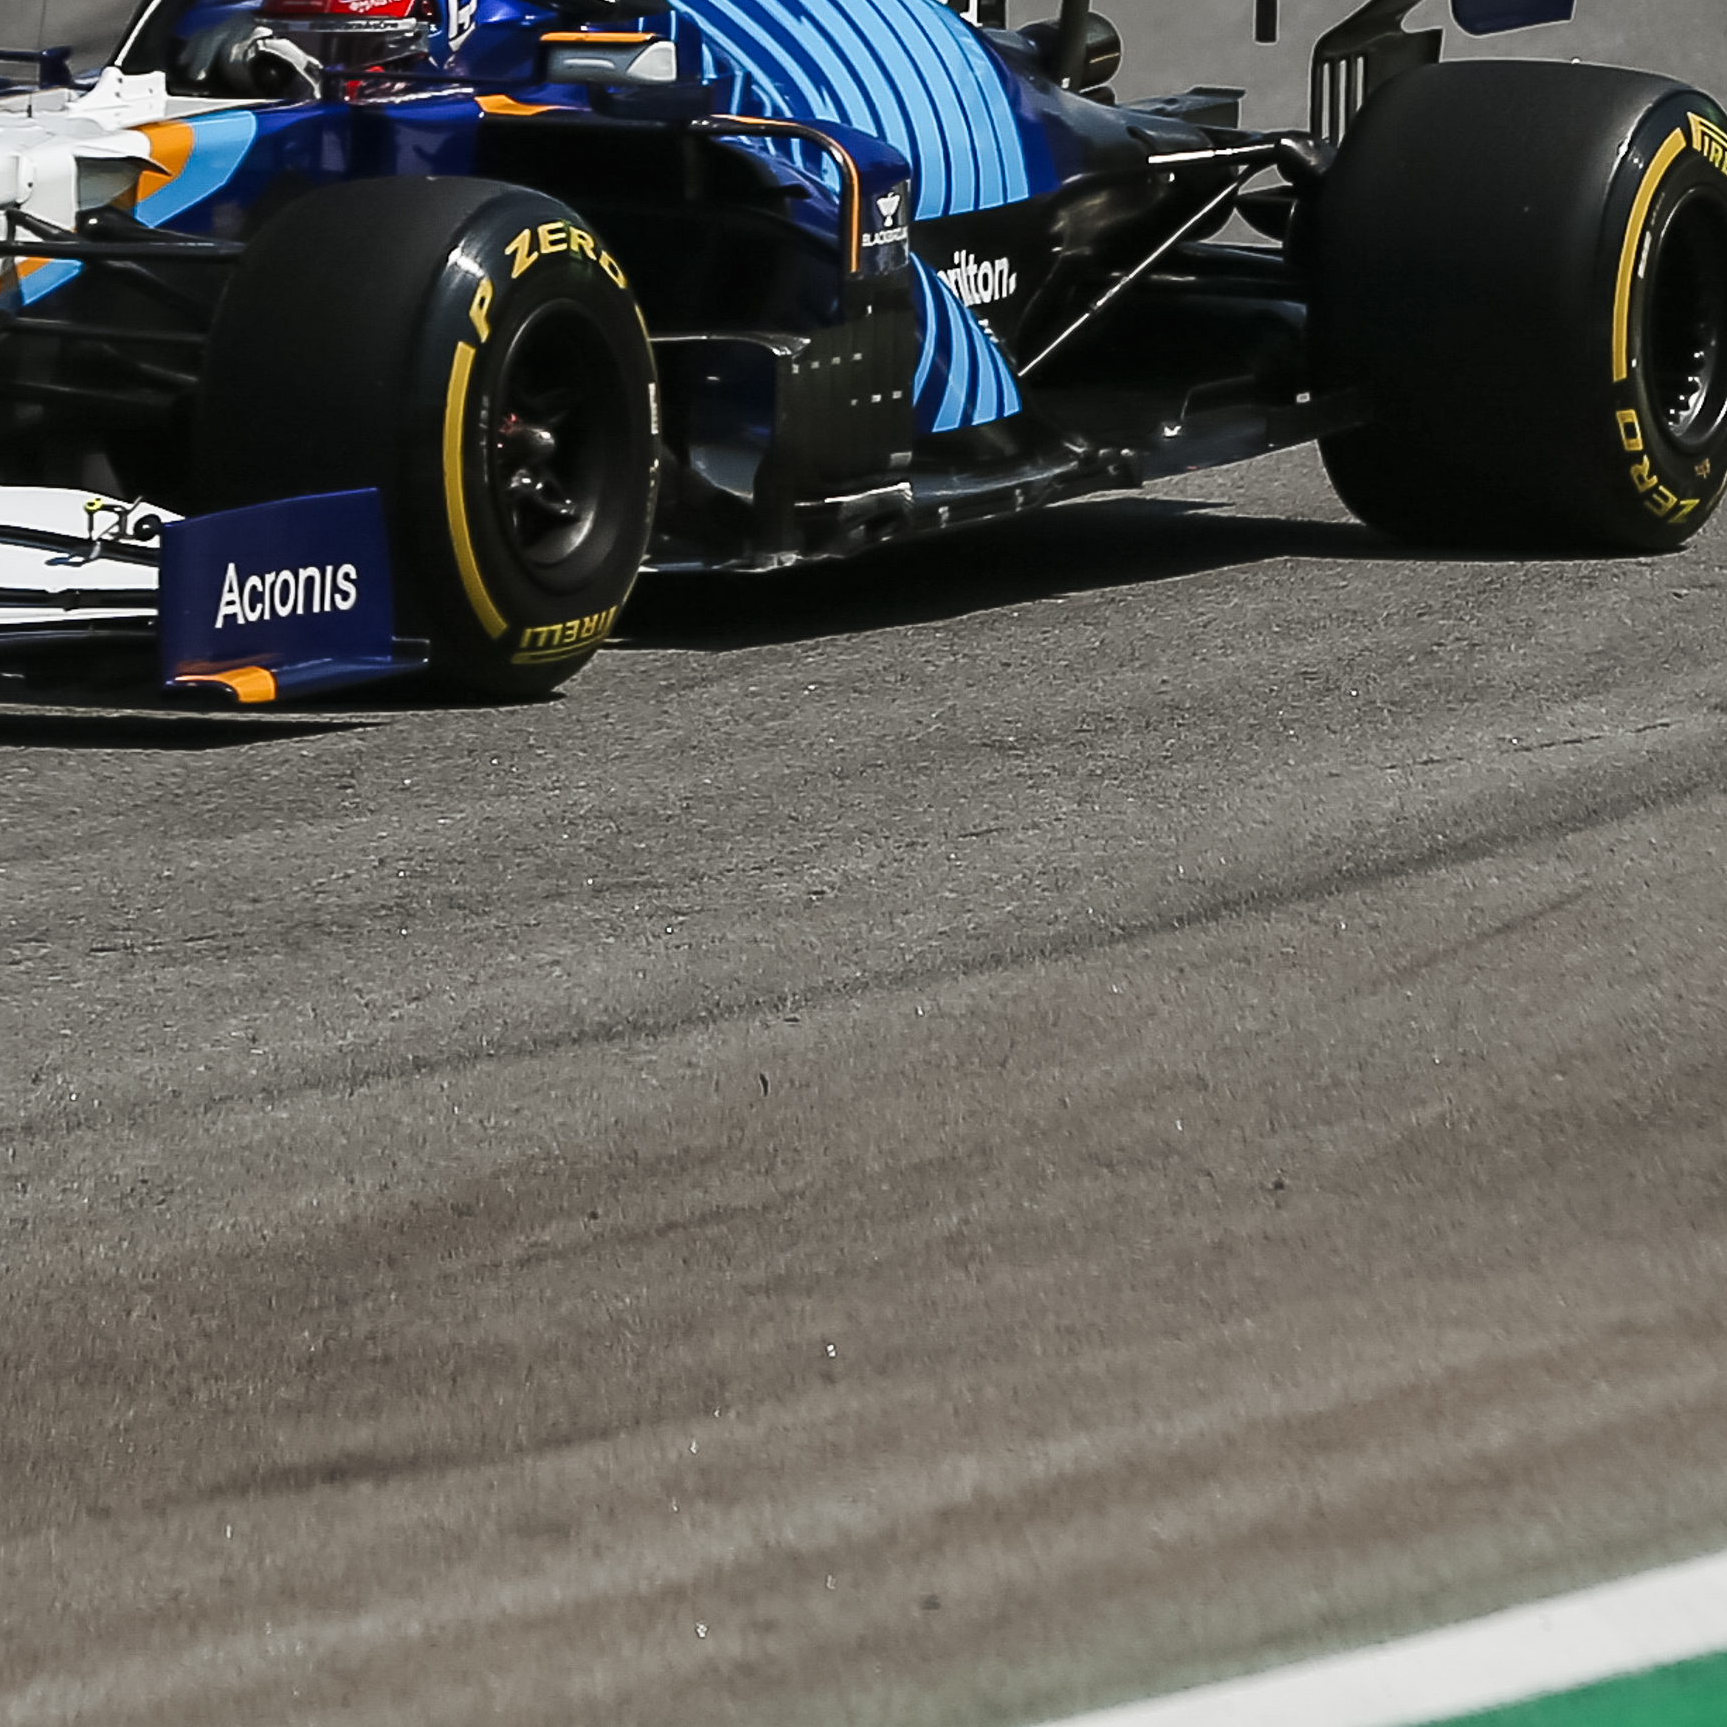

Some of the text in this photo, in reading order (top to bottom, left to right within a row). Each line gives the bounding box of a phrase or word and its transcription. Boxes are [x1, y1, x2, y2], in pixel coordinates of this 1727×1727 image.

[468, 220, 628, 344] P ZERO
[1615, 408, 1701, 524] ZERO
[214, 561, 358, 629] Acronis
